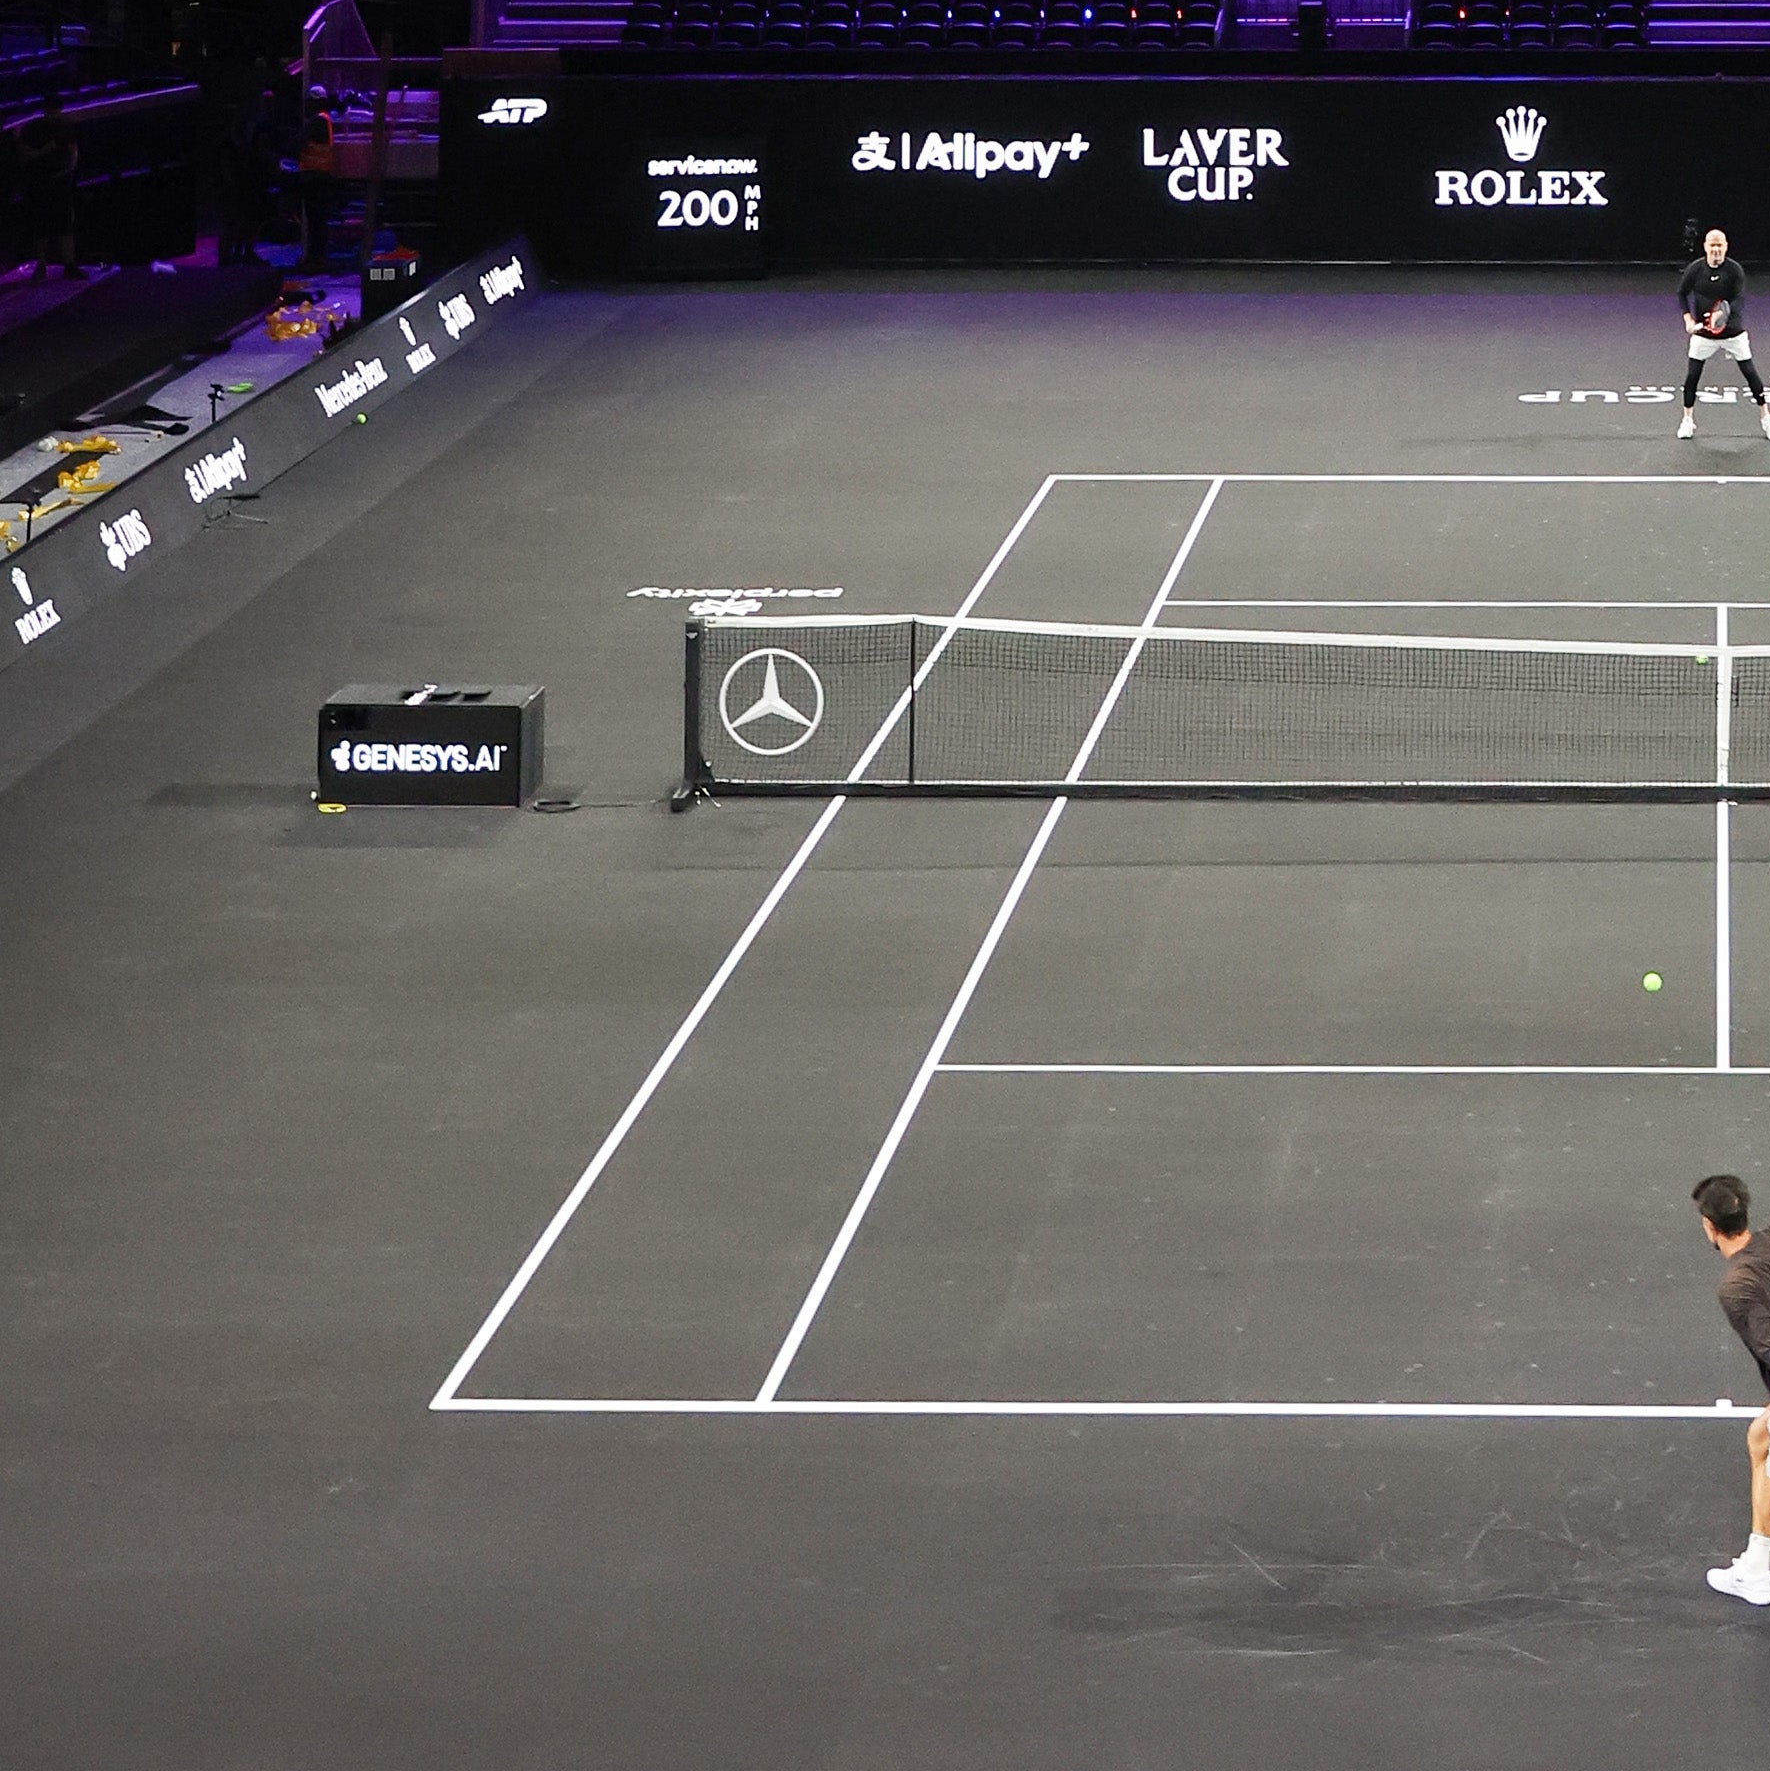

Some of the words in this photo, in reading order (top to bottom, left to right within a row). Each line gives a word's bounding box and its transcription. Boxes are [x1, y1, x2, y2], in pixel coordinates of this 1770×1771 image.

[477, 98, 548, 124] ATP
[1142, 128, 1290, 167] LAVER
[1434, 169, 1609, 206] ROLEX
[657, 189, 739, 227] 200
[1517, 390, 1675, 404] CUP
[14, 598, 62, 645] ROLEX
